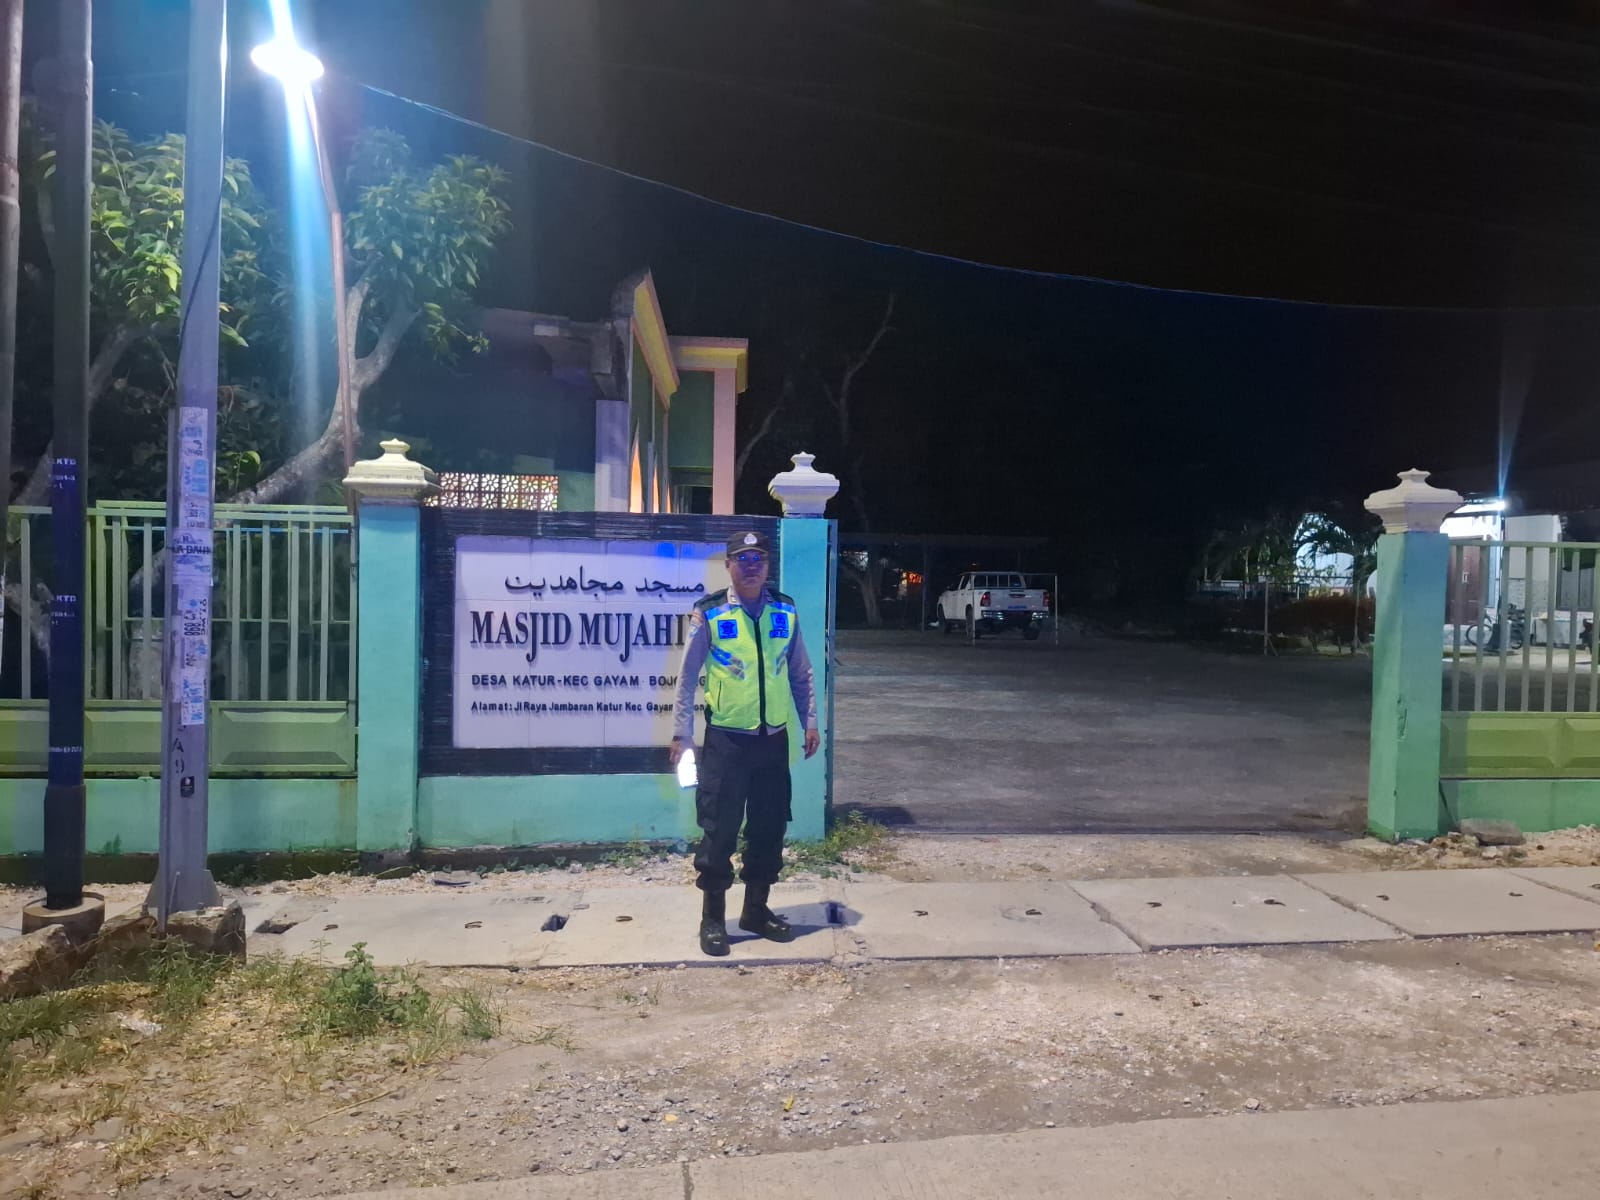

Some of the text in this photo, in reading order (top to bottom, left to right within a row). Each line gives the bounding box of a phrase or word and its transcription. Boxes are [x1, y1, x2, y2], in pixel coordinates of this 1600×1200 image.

[635, 577, 705, 598] مسجد
[470, 610, 693, 663] MASJID MUJAHI
[471, 674, 507, 687] DESA
[593, 675, 640, 687] GAYAM
[470, 701, 513, 712] Alamat:
[549, 701, 594, 712] Jambaran
[596, 702, 623, 712] Katur
[625, 702, 642, 712] Kec
